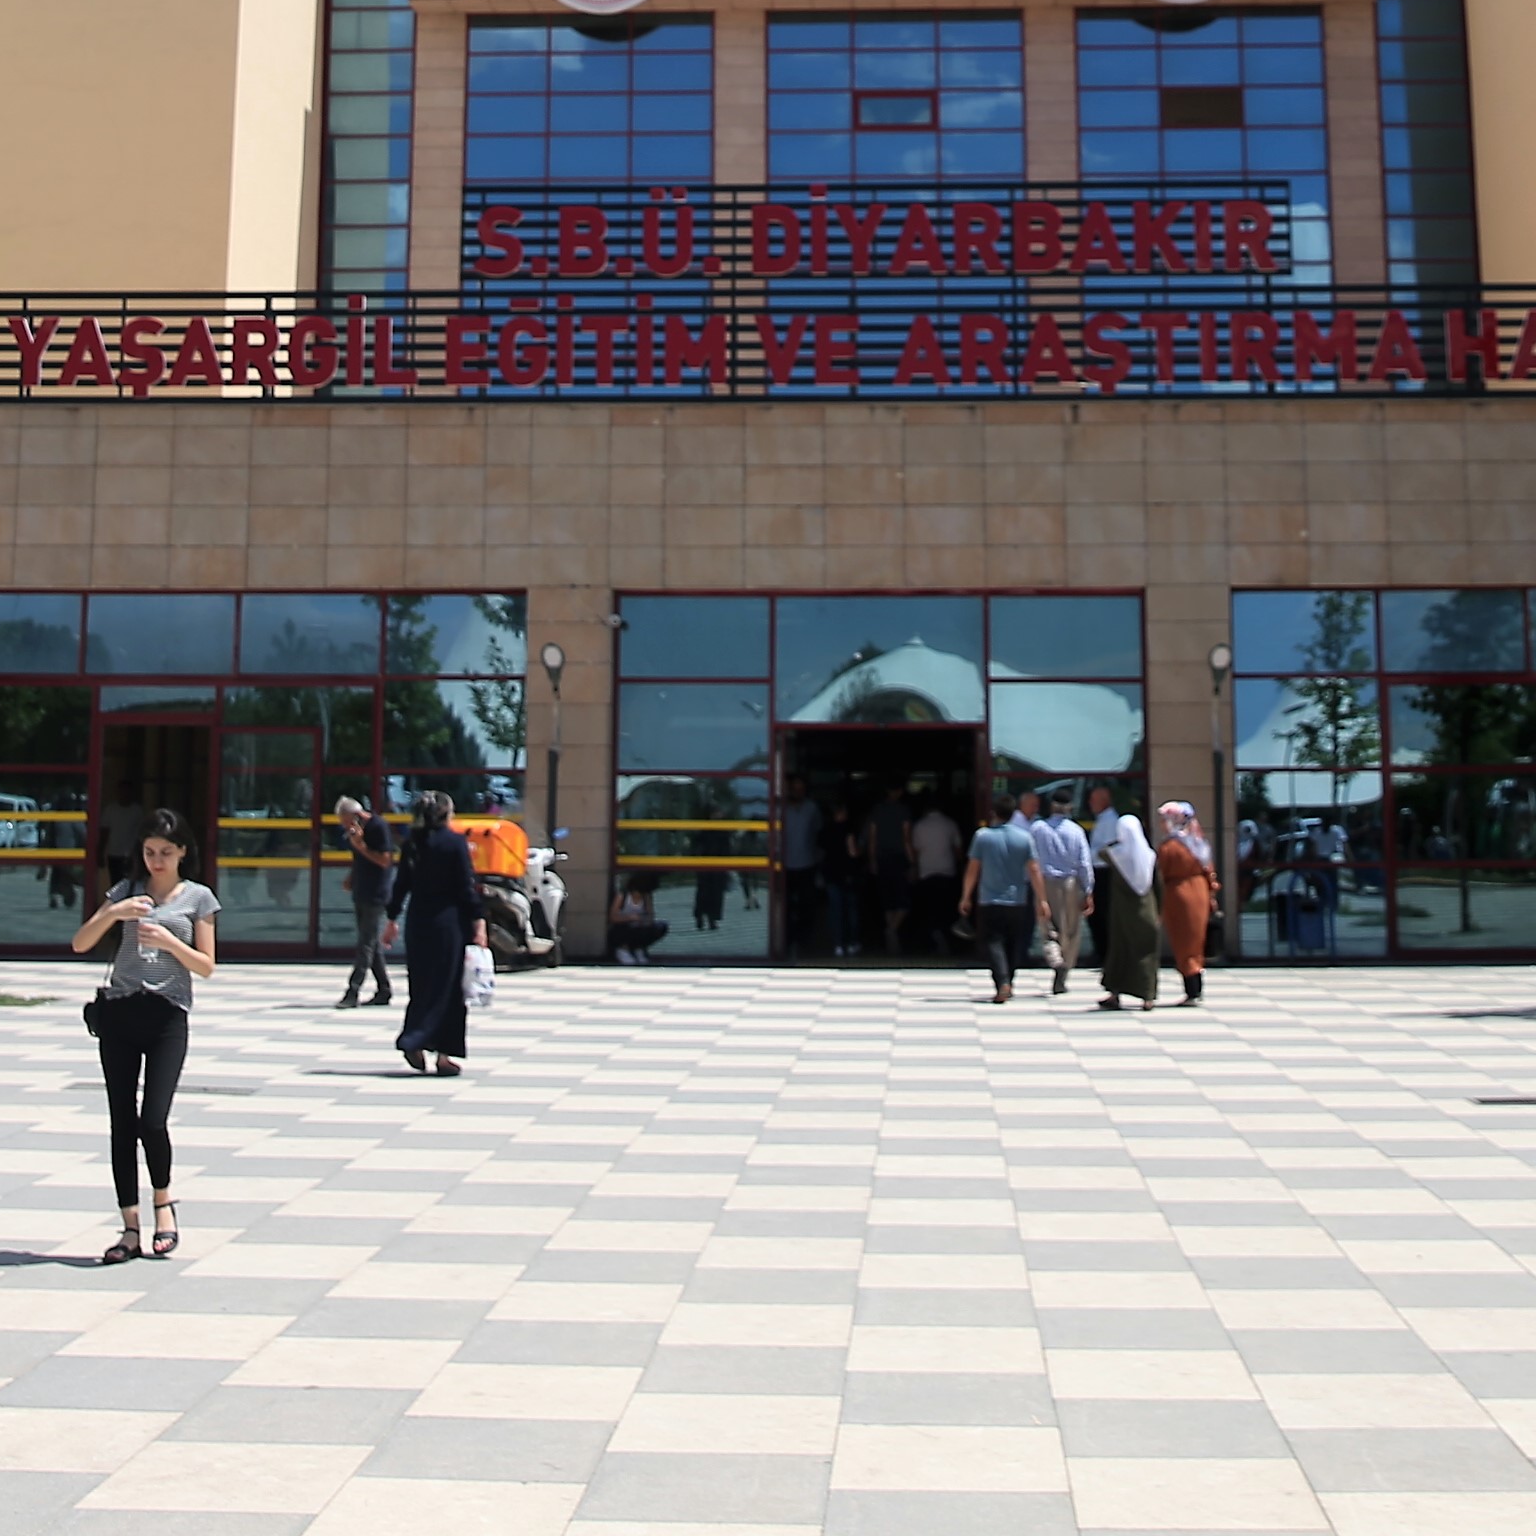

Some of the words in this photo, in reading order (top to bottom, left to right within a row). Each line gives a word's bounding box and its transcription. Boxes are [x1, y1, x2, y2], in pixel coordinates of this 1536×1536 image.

[474, 186, 723, 277] S.B.Ü.
[751, 183, 1279, 277] DİYARBAKIR
[7, 294, 418, 399] YAŞARGİL
[445, 293, 729, 388] EĞİTİM
[755, 313, 861, 386] VE
[893, 308, 1428, 396] ARAŞTIRMA
